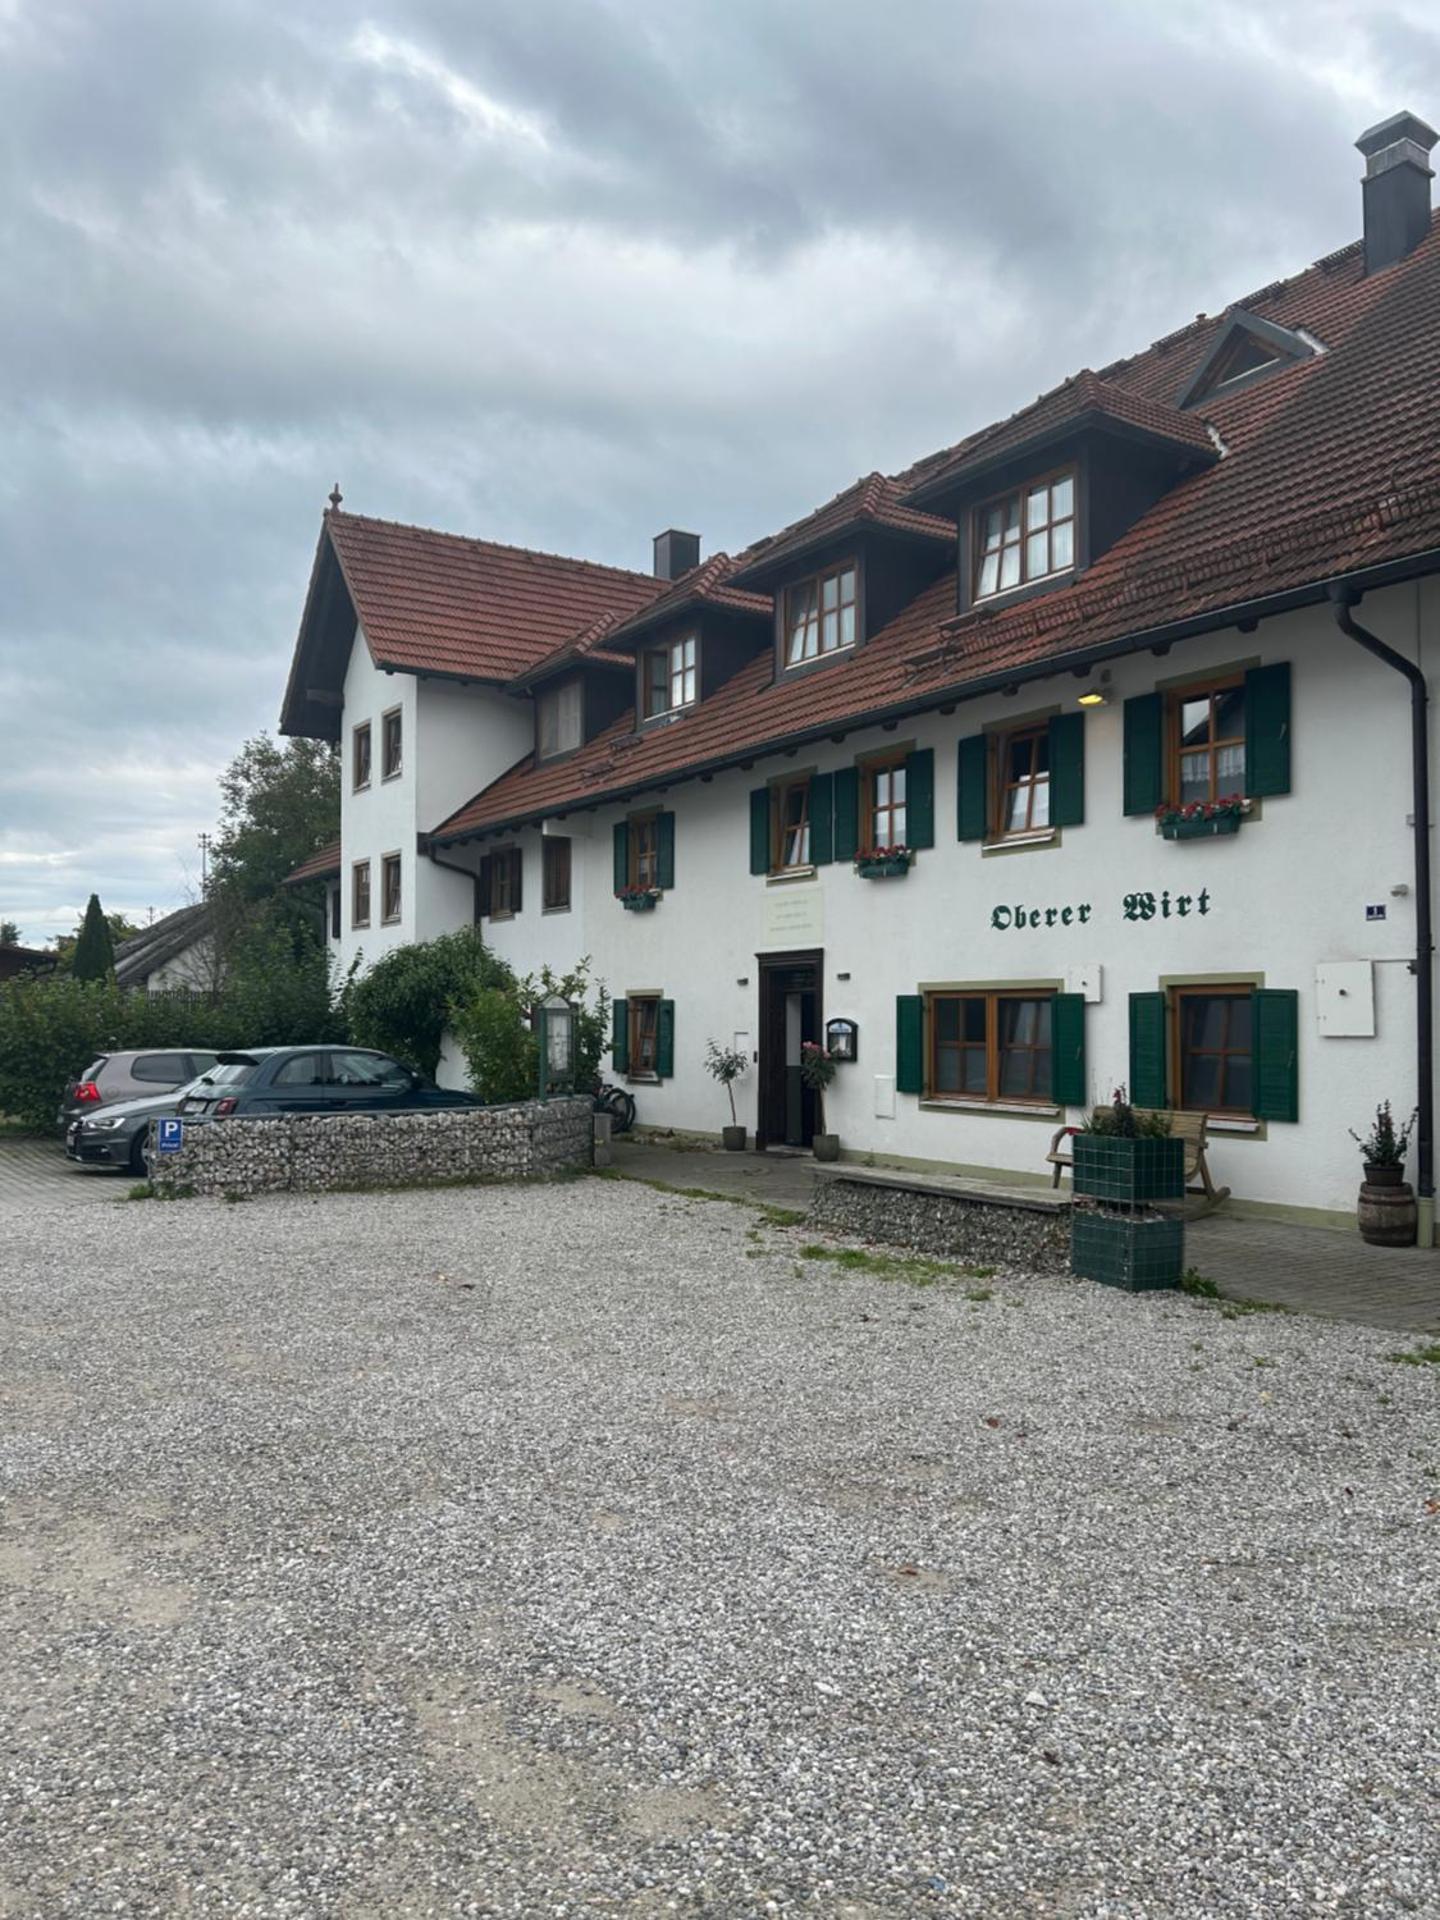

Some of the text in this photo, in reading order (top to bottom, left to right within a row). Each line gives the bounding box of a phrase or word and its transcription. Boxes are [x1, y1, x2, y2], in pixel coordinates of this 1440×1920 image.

[991, 888, 1211, 930] Oberer Wirt
[165, 1121, 178, 1137] P
